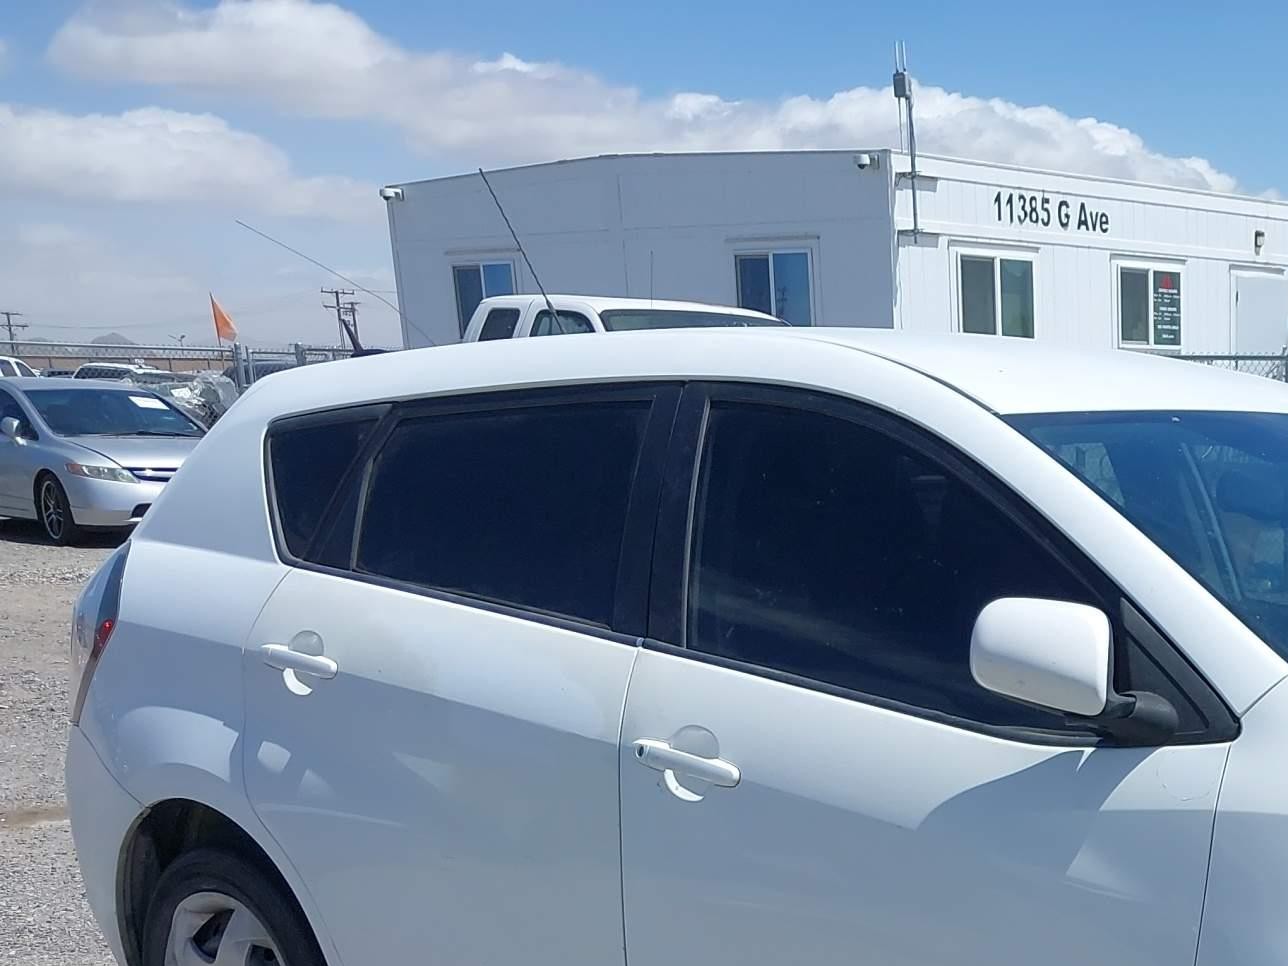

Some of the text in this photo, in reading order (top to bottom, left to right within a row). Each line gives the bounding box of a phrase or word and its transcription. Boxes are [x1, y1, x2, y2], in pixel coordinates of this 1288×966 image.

[994, 191, 1109, 233] 11385 G Ave
